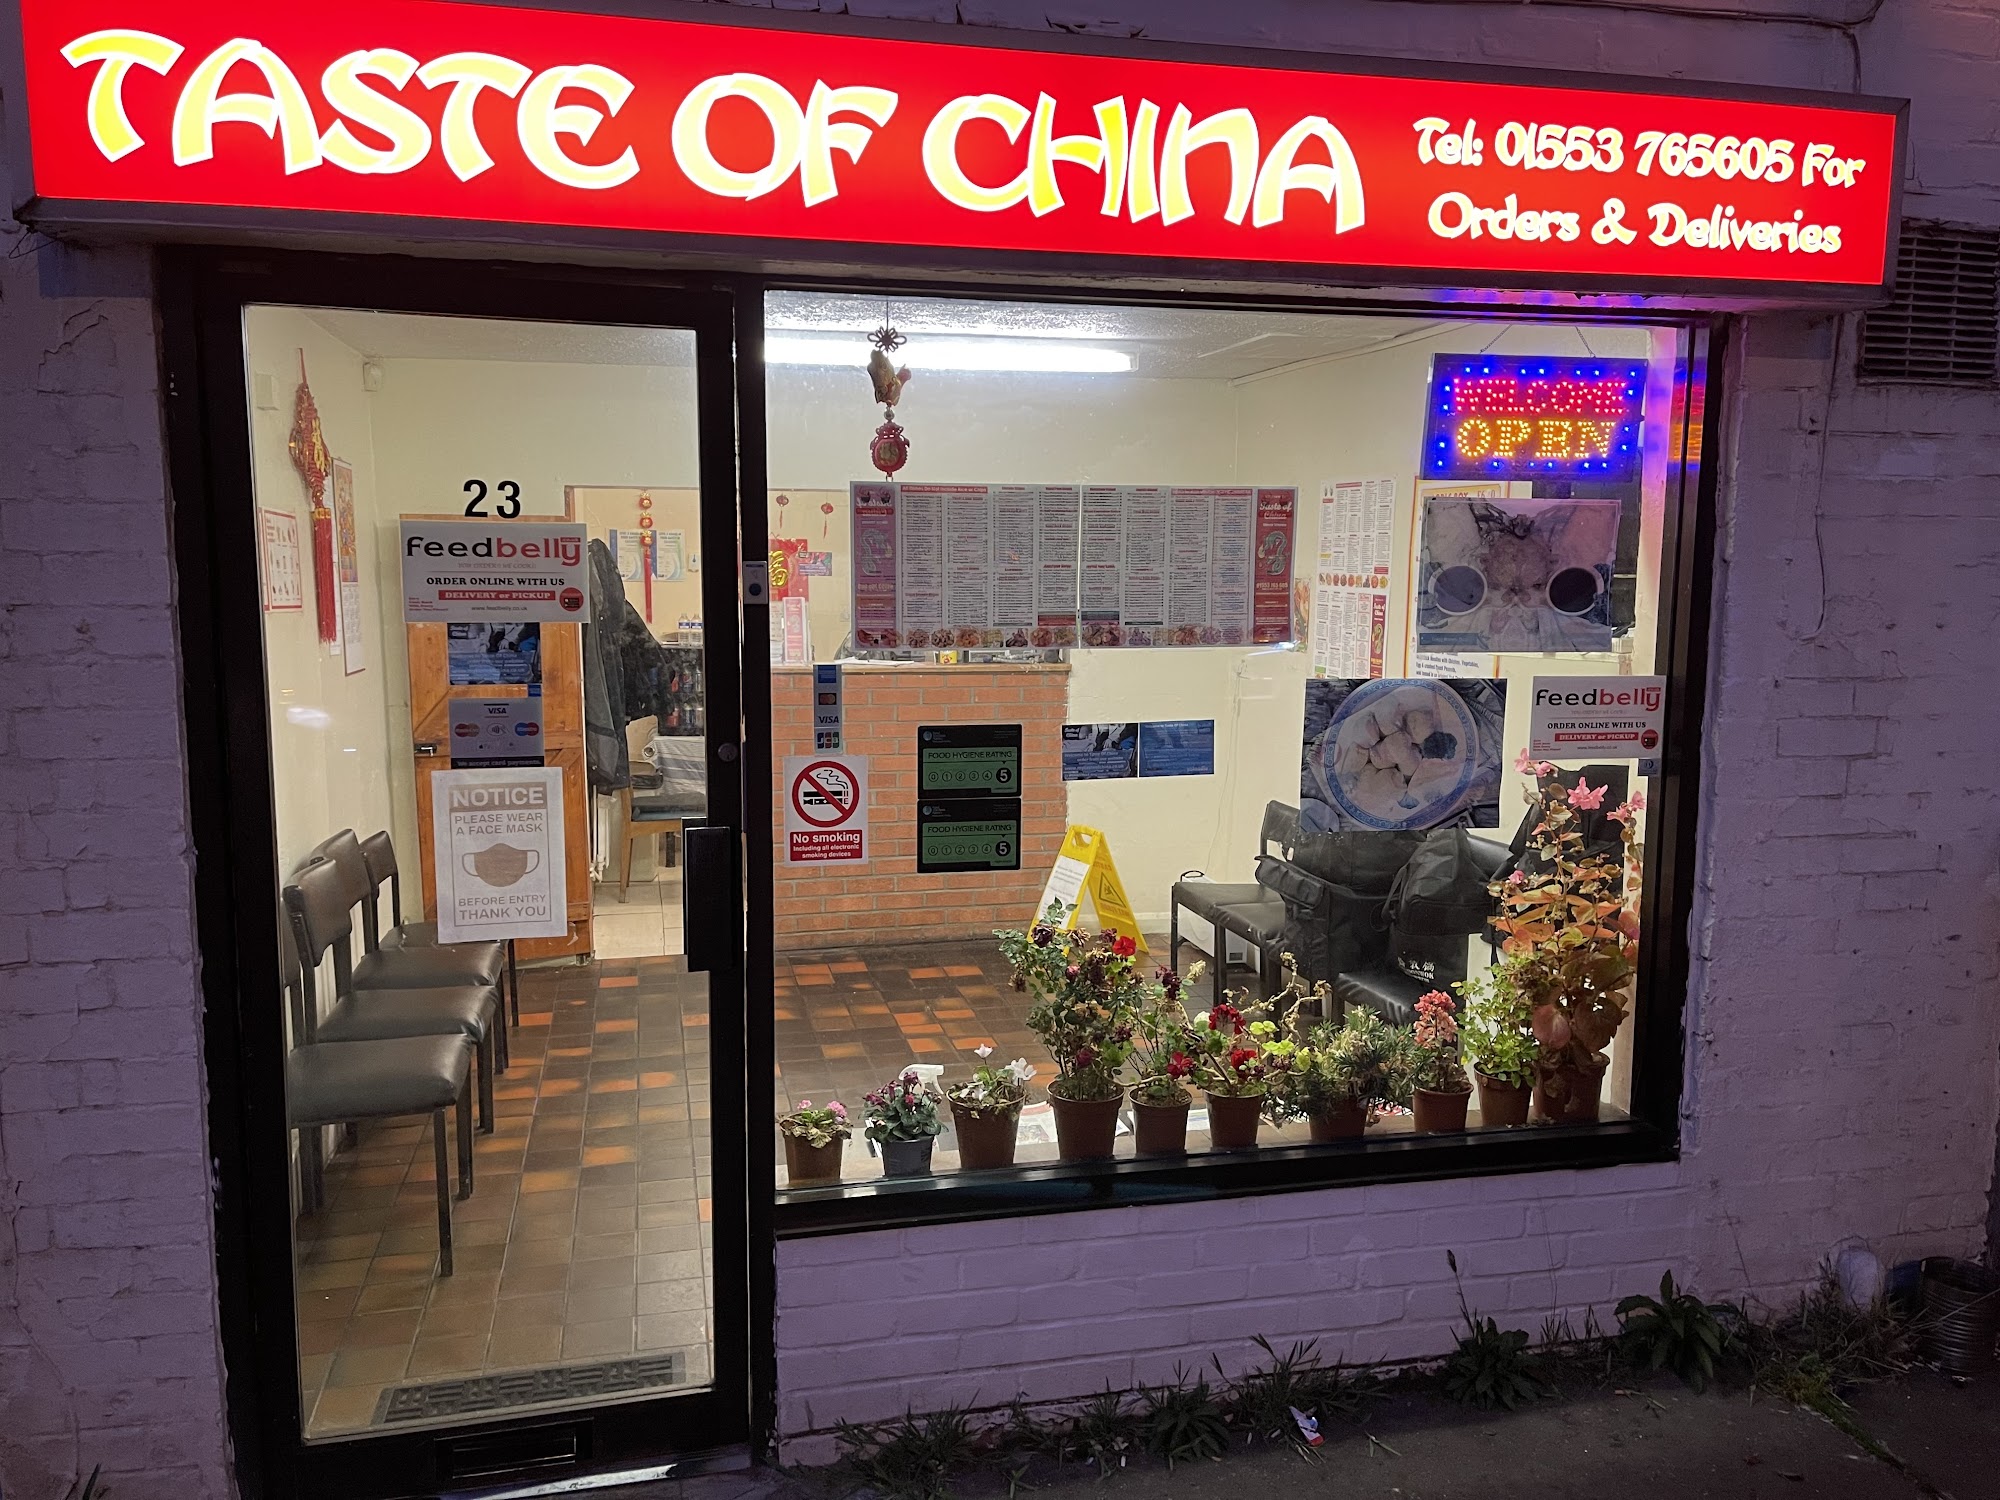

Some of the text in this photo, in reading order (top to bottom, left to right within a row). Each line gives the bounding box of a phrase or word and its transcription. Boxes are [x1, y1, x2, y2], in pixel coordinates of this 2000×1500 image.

[61, 29, 1366, 234] TASTE OF CHINA
[1413, 117, 1866, 189] Tel: 01553 765605 For
[1428, 191, 1842, 254] Orders & Deliveries
[1457, 419, 1616, 458] OPEN
[463, 479, 521, 519] 23
[406, 536, 581, 567] feedbelly
[426, 577, 565, 586] ORDER ONLINE WITH US
[1535, 688, 1661, 712] feedbelly
[953, 751, 986, 759] HYGIENE
[986, 750, 1012, 758] RATING
[453, 787, 544, 807] NOTICE
[454, 812, 543, 824] PLEASE WEAR
[456, 823, 543, 835] A FACE MASK
[793, 832, 860, 843] No smoking
[458, 895, 546, 907] BEFORE ENTRY
[459, 906, 546, 921] THANK YOU
